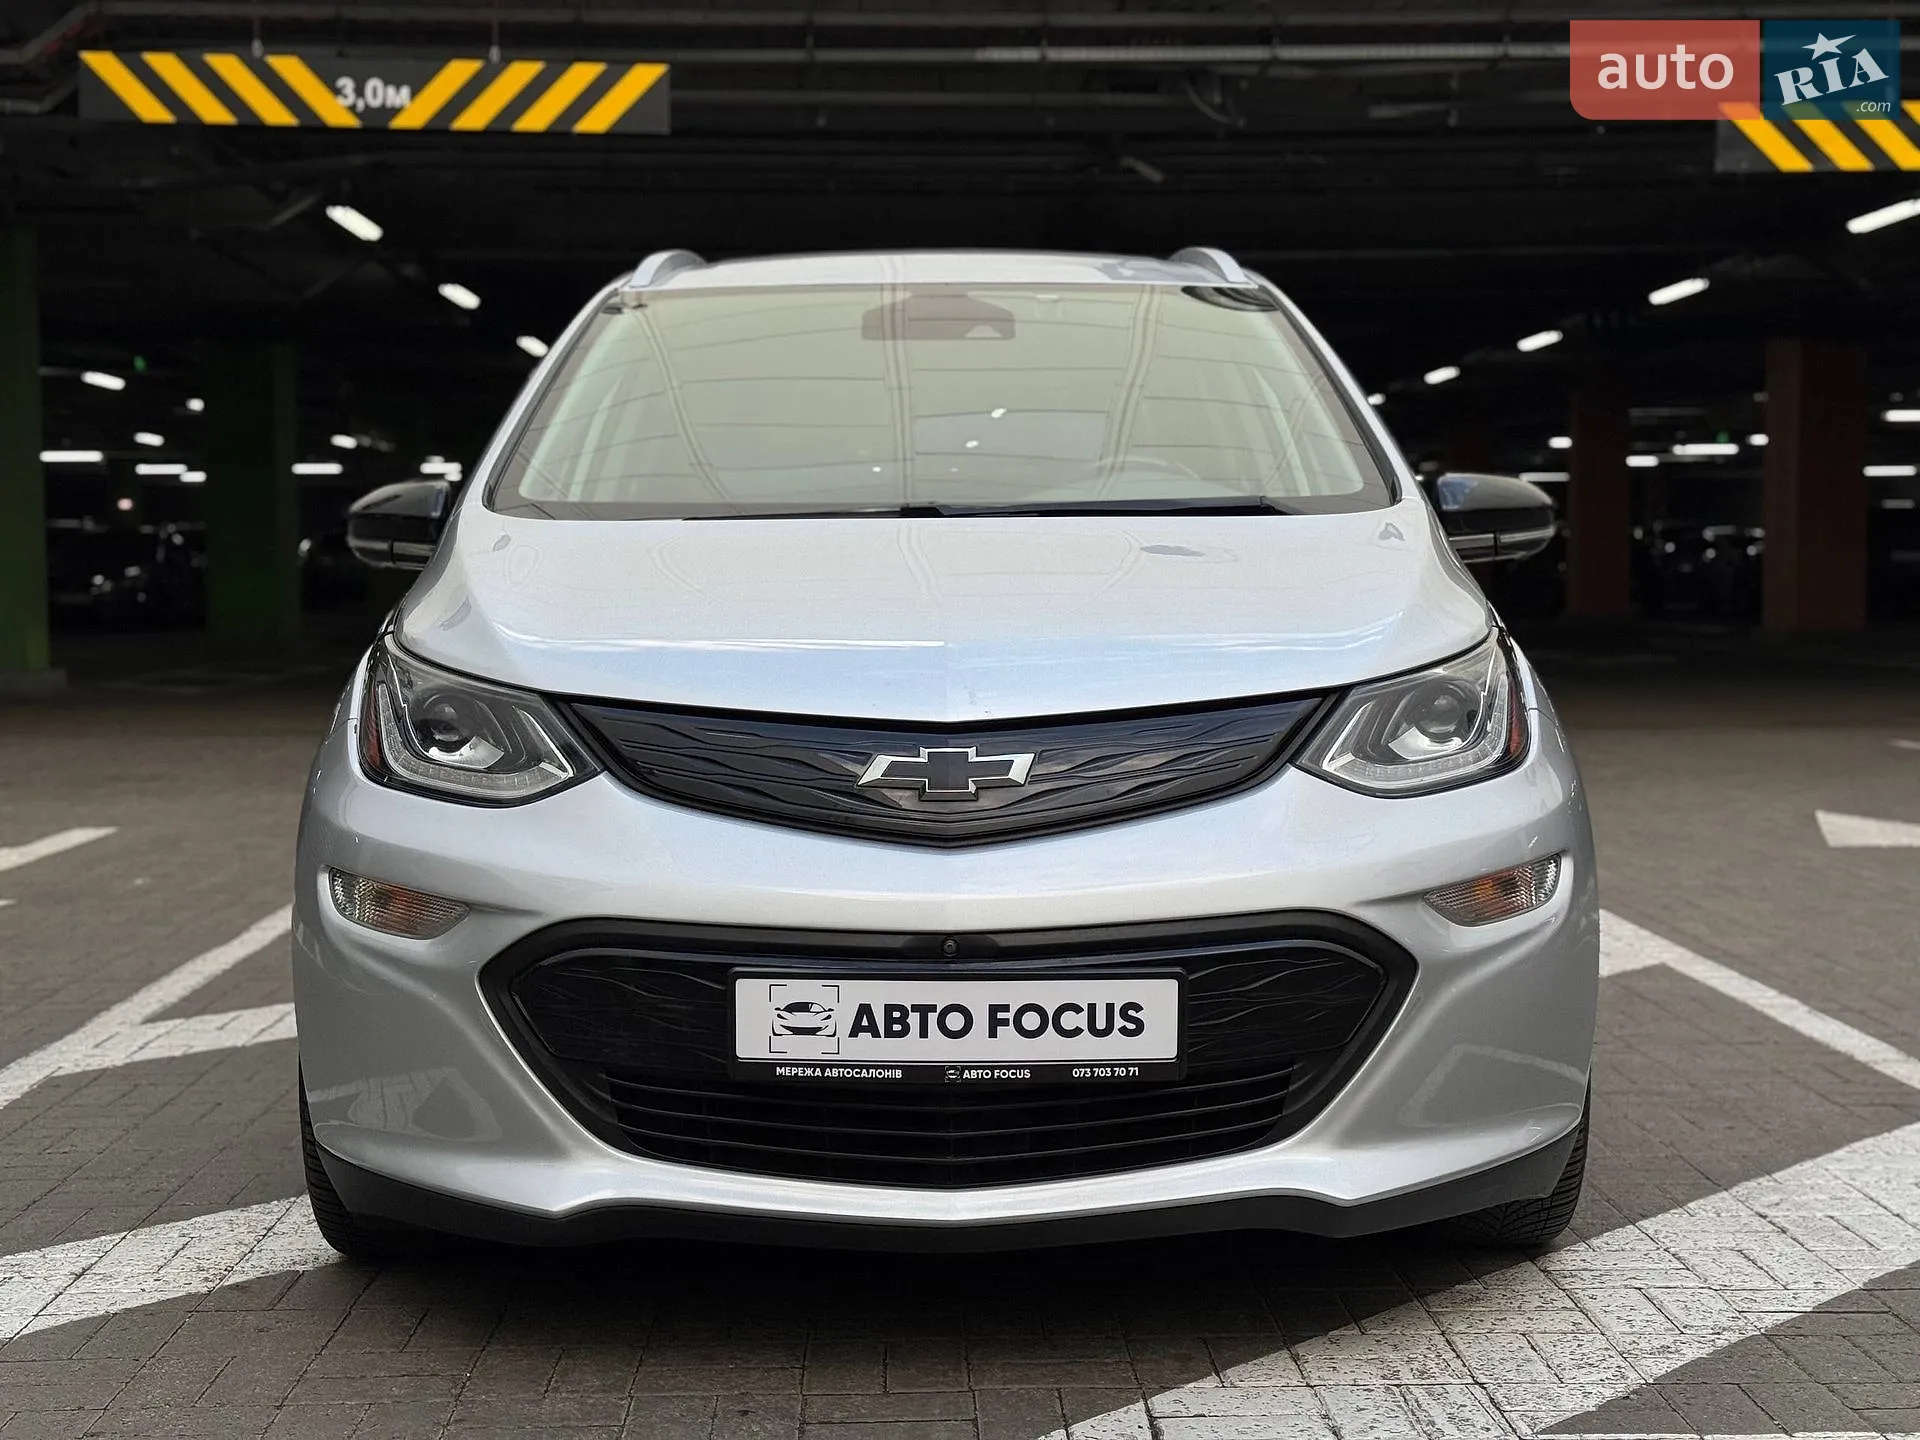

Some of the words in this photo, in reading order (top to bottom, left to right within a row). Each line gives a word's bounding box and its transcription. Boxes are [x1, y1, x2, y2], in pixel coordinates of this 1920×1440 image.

[848, 1003, 974, 1040] АВТО
[988, 1001, 1145, 1039] FOCUS
[776, 1066, 822, 1077] МЕРЕЖА
[824, 1067, 903, 1079] АВТОСАЛОНІВ
[963, 1069, 991, 1079] АВТО
[994, 1069, 1031, 1079] FOCUS
[1072, 1068, 1091, 1077] 073
[1093, 1067, 1112, 1077] 703
[1114, 1067, 1126, 1077] 70
[1128, 1067, 1139, 1076] 71
